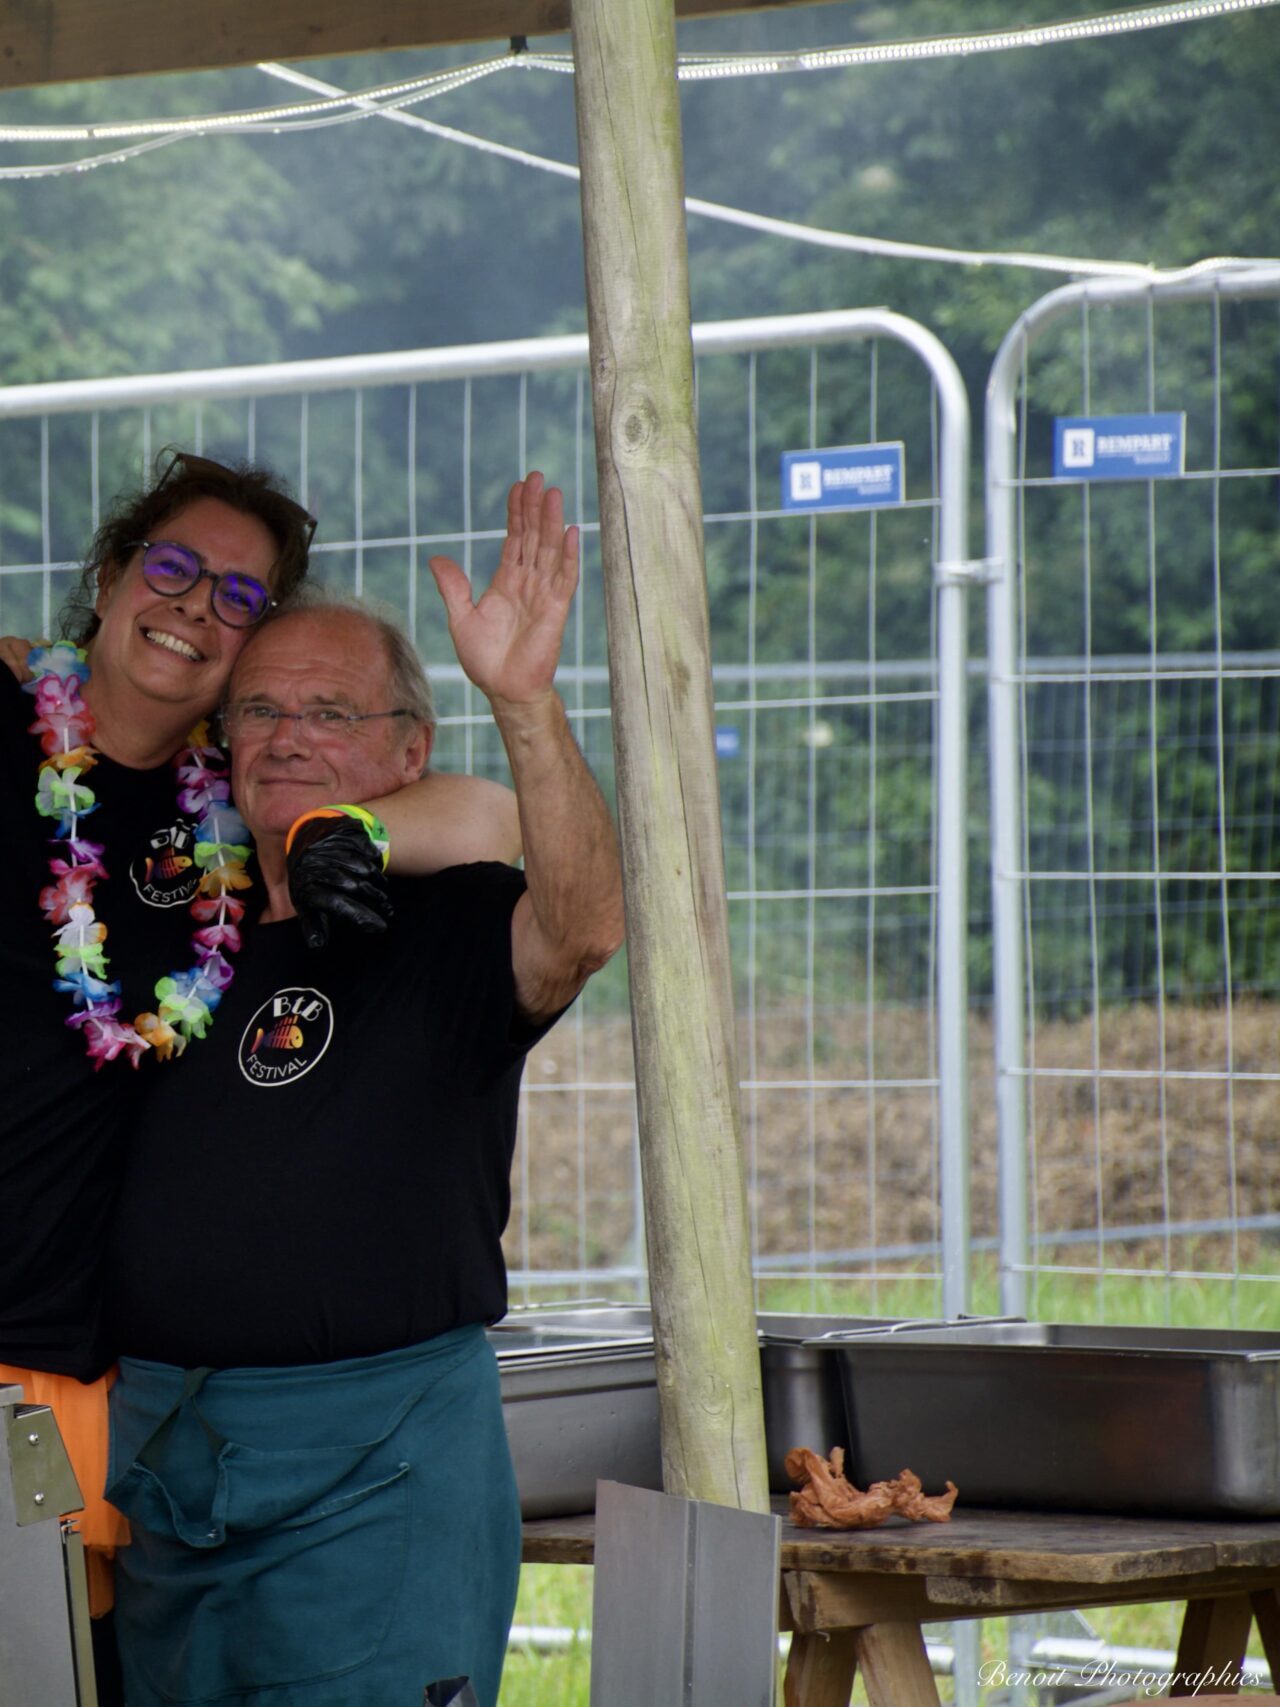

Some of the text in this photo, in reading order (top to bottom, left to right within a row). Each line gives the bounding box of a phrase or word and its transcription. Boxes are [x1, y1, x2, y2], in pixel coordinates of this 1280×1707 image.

[1097, 433, 1172, 454] REMPART
[823, 465, 893, 487] REMPART
[143, 878, 198, 903] FESTIV
[273, 996, 323, 1021] BtB
[246, 1054, 307, 1080] FESTIVAL
